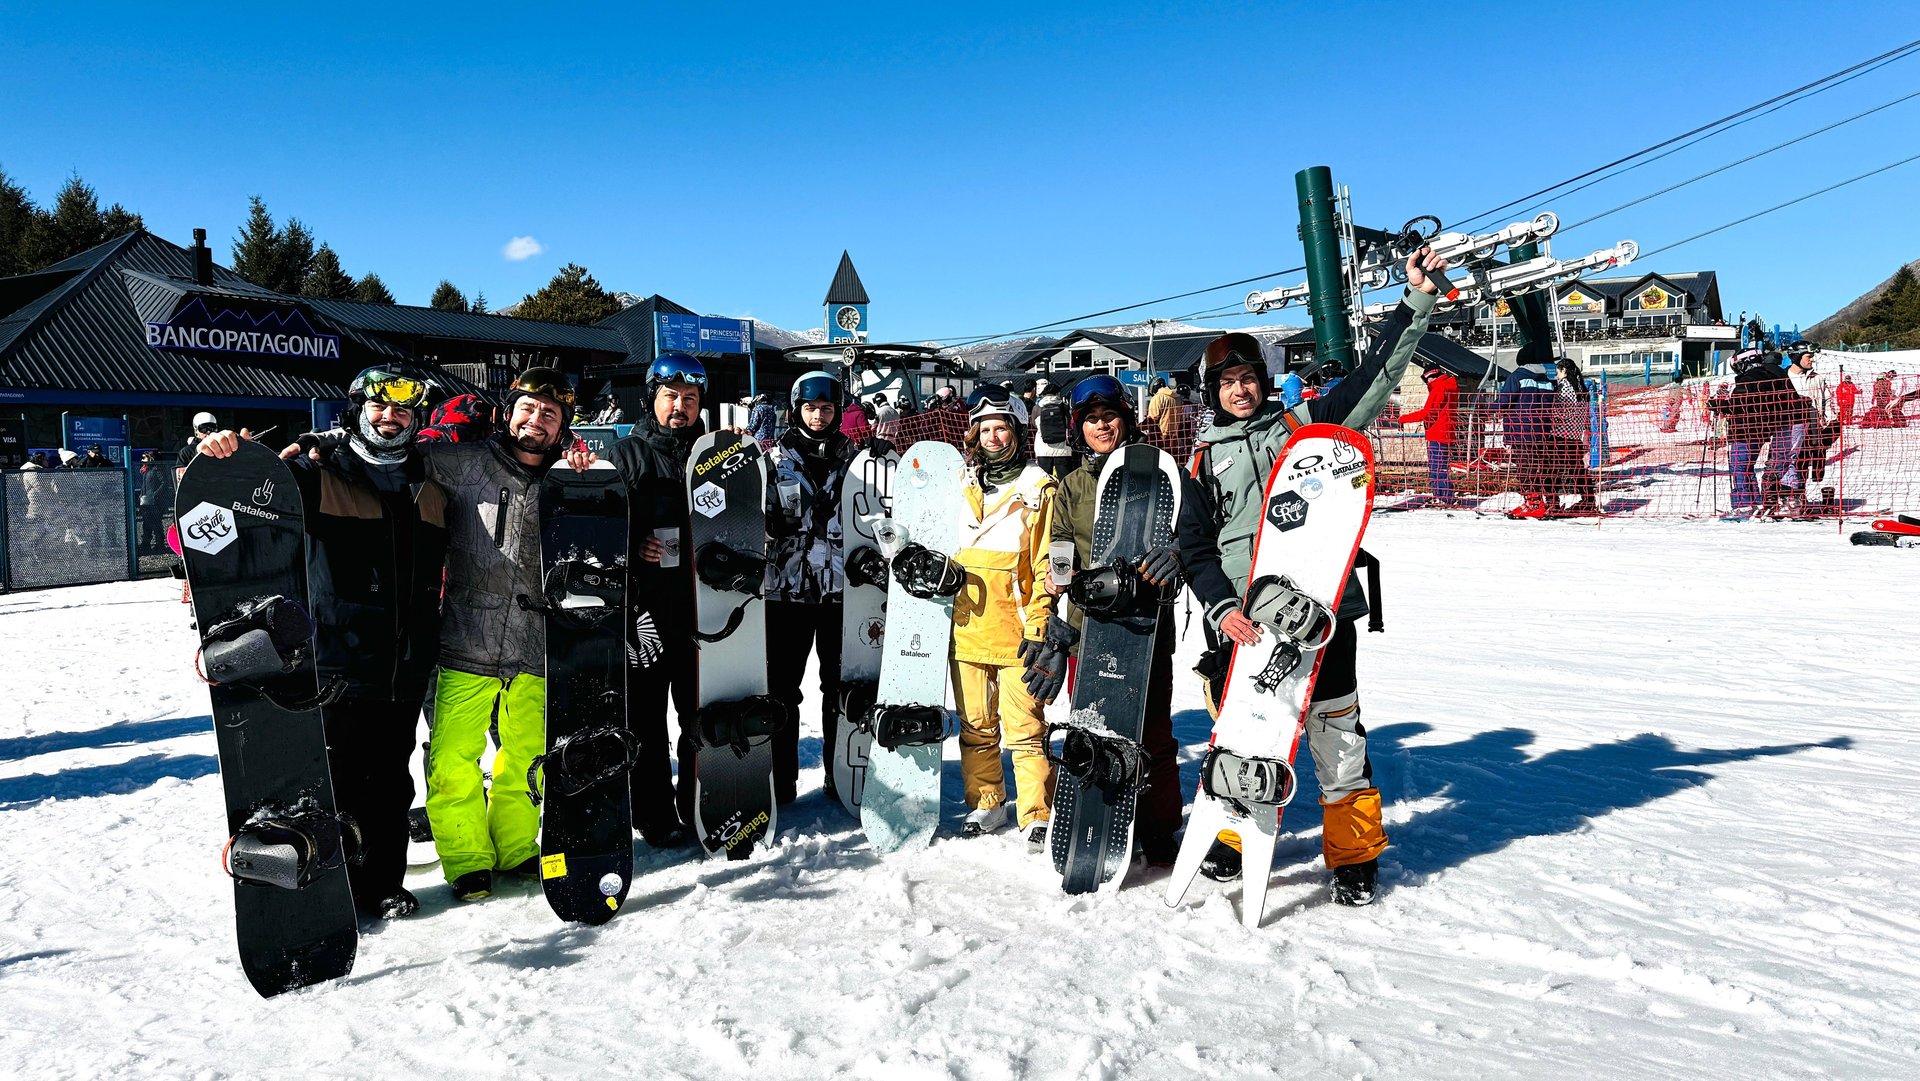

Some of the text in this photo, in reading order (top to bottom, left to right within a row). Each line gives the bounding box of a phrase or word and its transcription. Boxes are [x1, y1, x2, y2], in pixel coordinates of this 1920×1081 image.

[149, 324, 340, 359] BANCOPATAGONIA
[709, 328, 741, 337] PRINCESITA
[1132, 373, 1162, 382] SALD
[583, 440, 604, 451] CTA
[695, 441, 743, 476] Bataleon
[720, 455, 753, 480] OAKLEY
[1332, 459, 1368, 476] BATALEON
[1288, 462, 1334, 481] OAKLEY
[231, 501, 279, 521] Bataleon
[901, 649, 930, 658] Bataleon
[1099, 670, 1125, 680] Bataleon
[711, 810, 742, 840] OAKLEY
[724, 811, 769, 851] Bataleon
